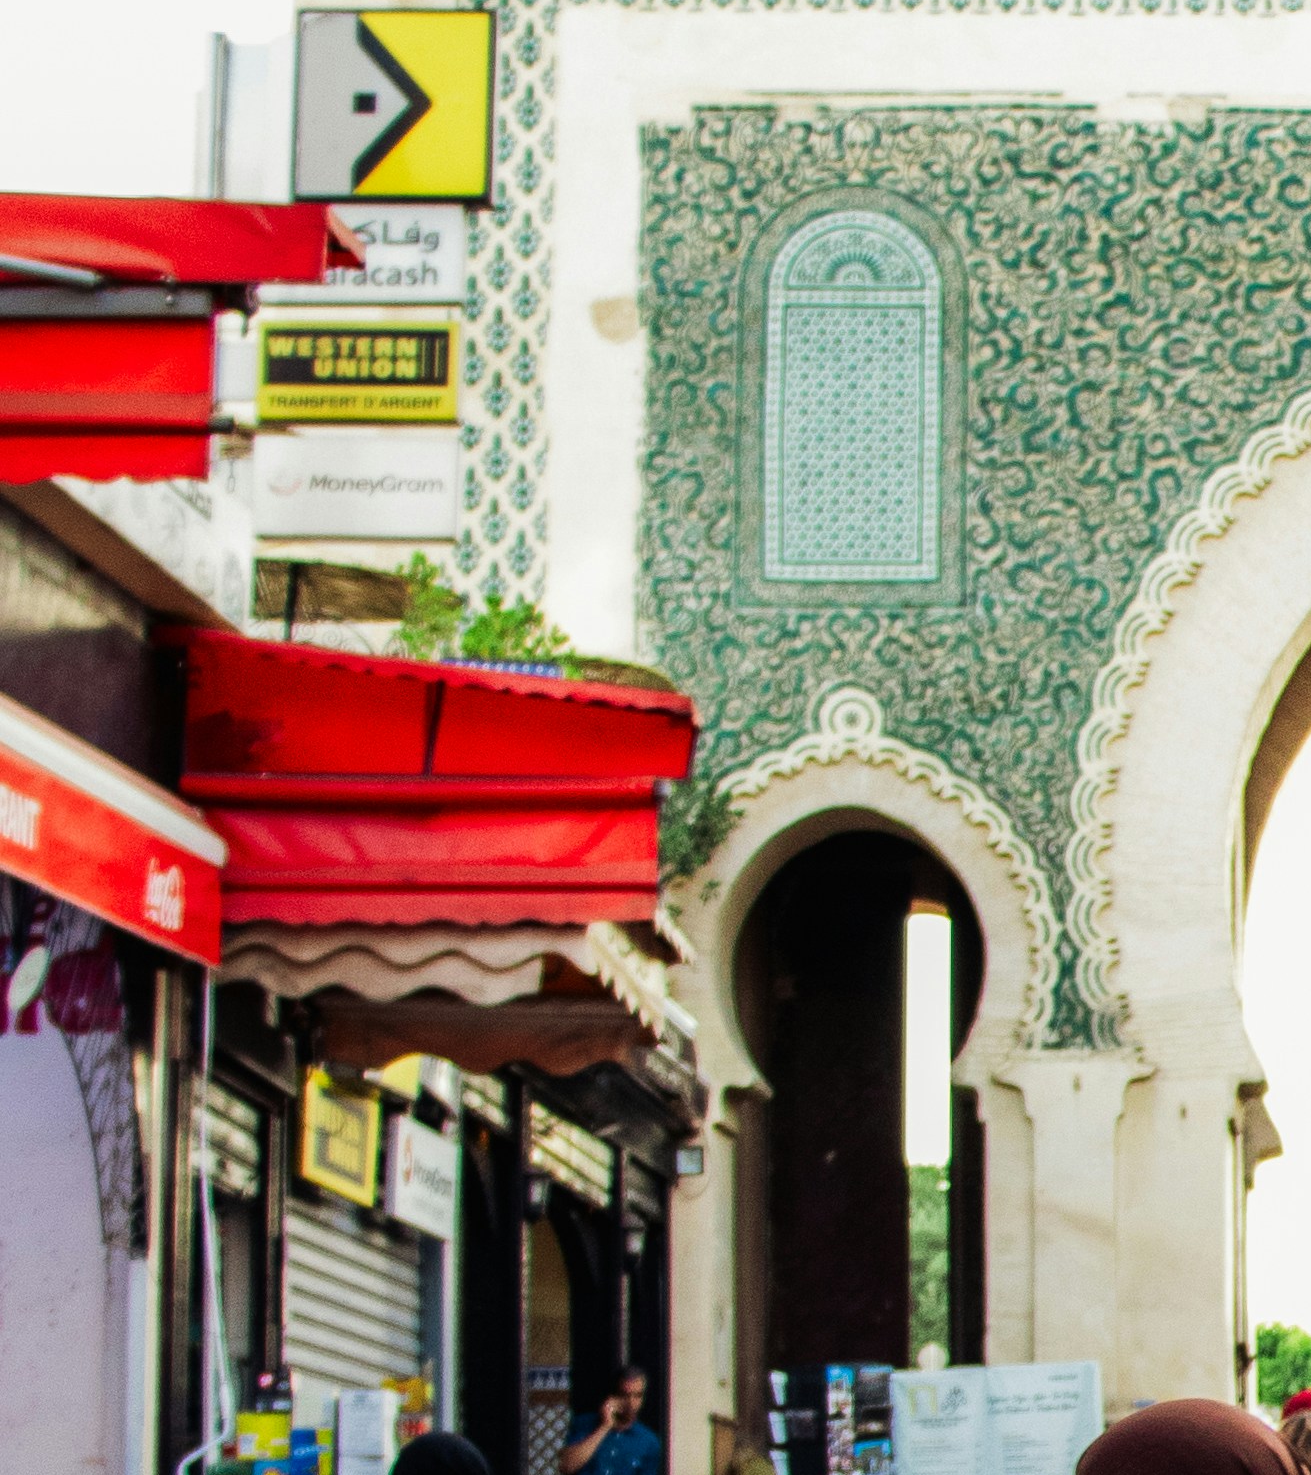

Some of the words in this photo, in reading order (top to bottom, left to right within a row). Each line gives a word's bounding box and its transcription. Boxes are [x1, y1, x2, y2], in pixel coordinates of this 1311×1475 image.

[267, 336, 418, 358] WESTERN
[313, 357, 418, 380] UNION
[269, 394, 358, 411] TRANSFERT
[308, 474, 445, 499] MoneyGram
